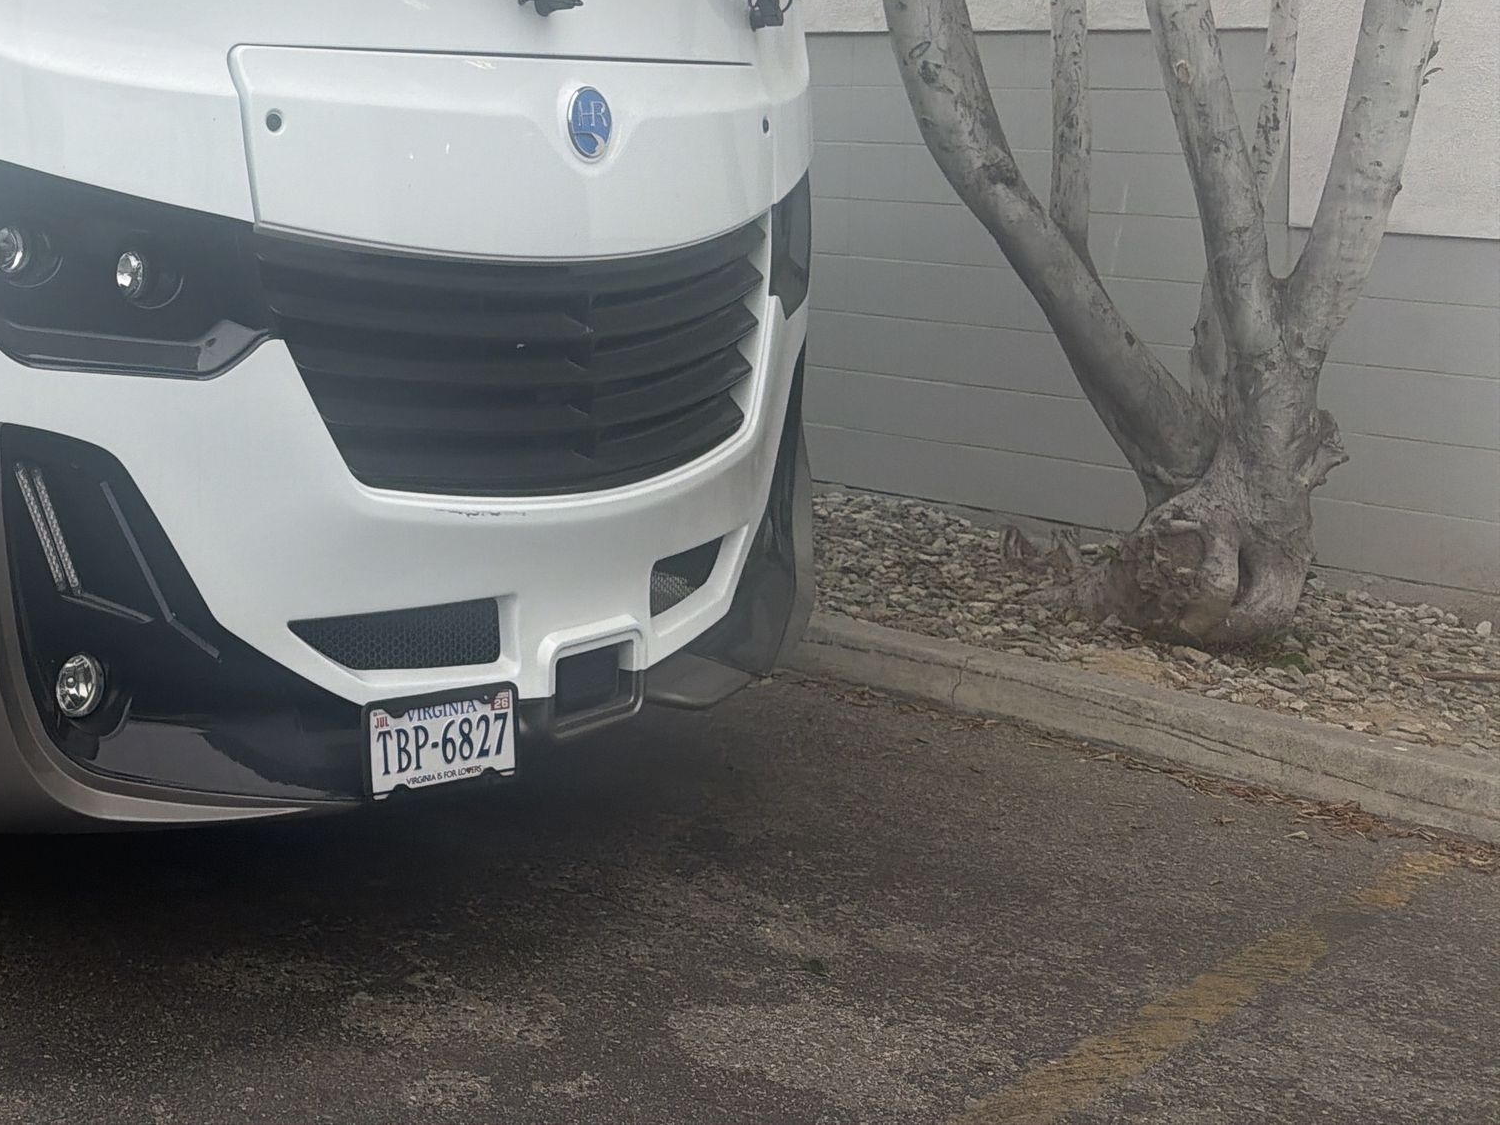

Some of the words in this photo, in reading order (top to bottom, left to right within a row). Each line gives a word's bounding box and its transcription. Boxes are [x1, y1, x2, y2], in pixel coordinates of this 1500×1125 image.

[494, 697, 509, 709] 26
[406, 700, 478, 723] VIRGINIA
[374, 716, 390, 729] JUL
[376, 712, 509, 776] TBP-6827
[406, 773, 436, 785] VIRGINIA
[443, 769, 457, 779] FOR
